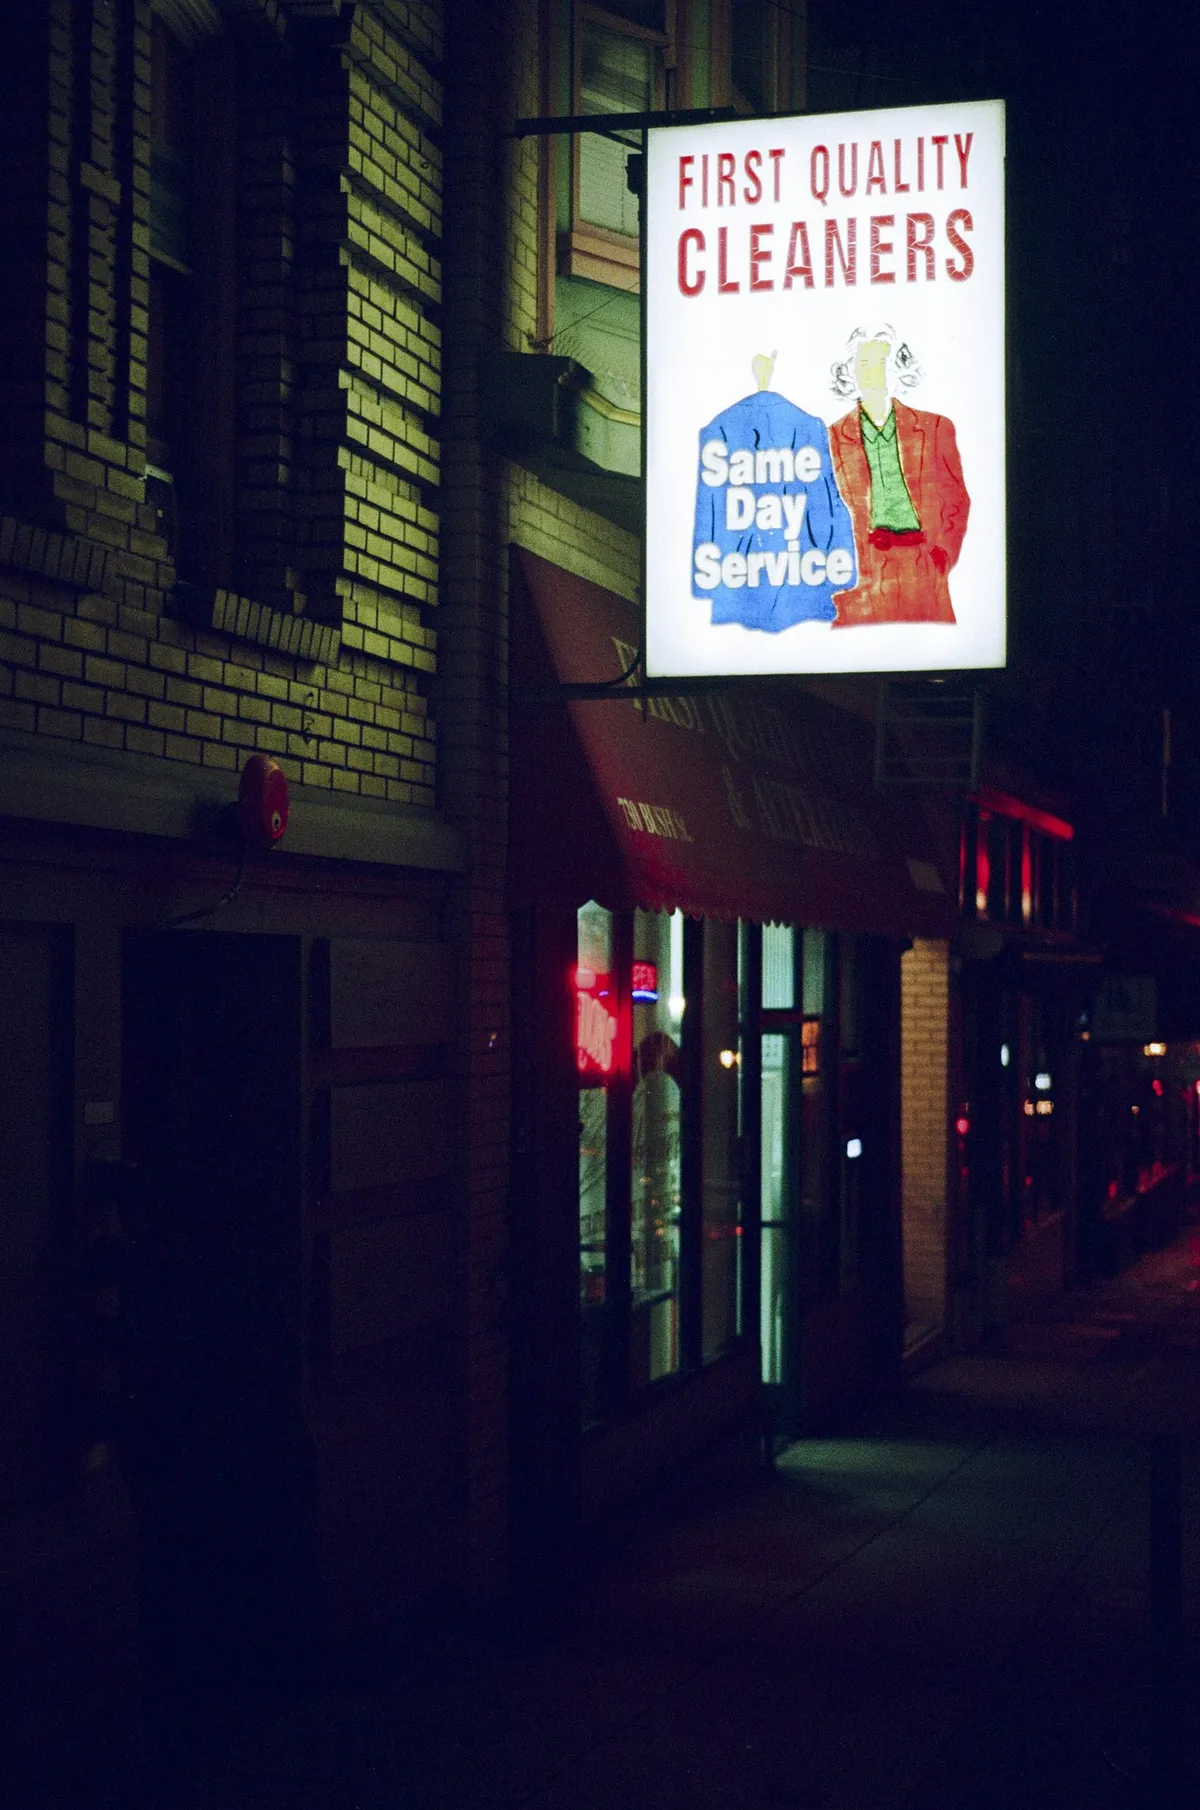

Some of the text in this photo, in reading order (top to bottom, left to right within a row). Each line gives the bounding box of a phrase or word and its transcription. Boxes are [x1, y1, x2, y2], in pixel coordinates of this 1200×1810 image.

[678, 132, 974, 210] FIRST QUALITY
[677, 208, 974, 298] CLEANERS
[701, 439, 822, 487] Same
[726, 487, 807, 541] Day
[694, 543, 853, 590] Service
